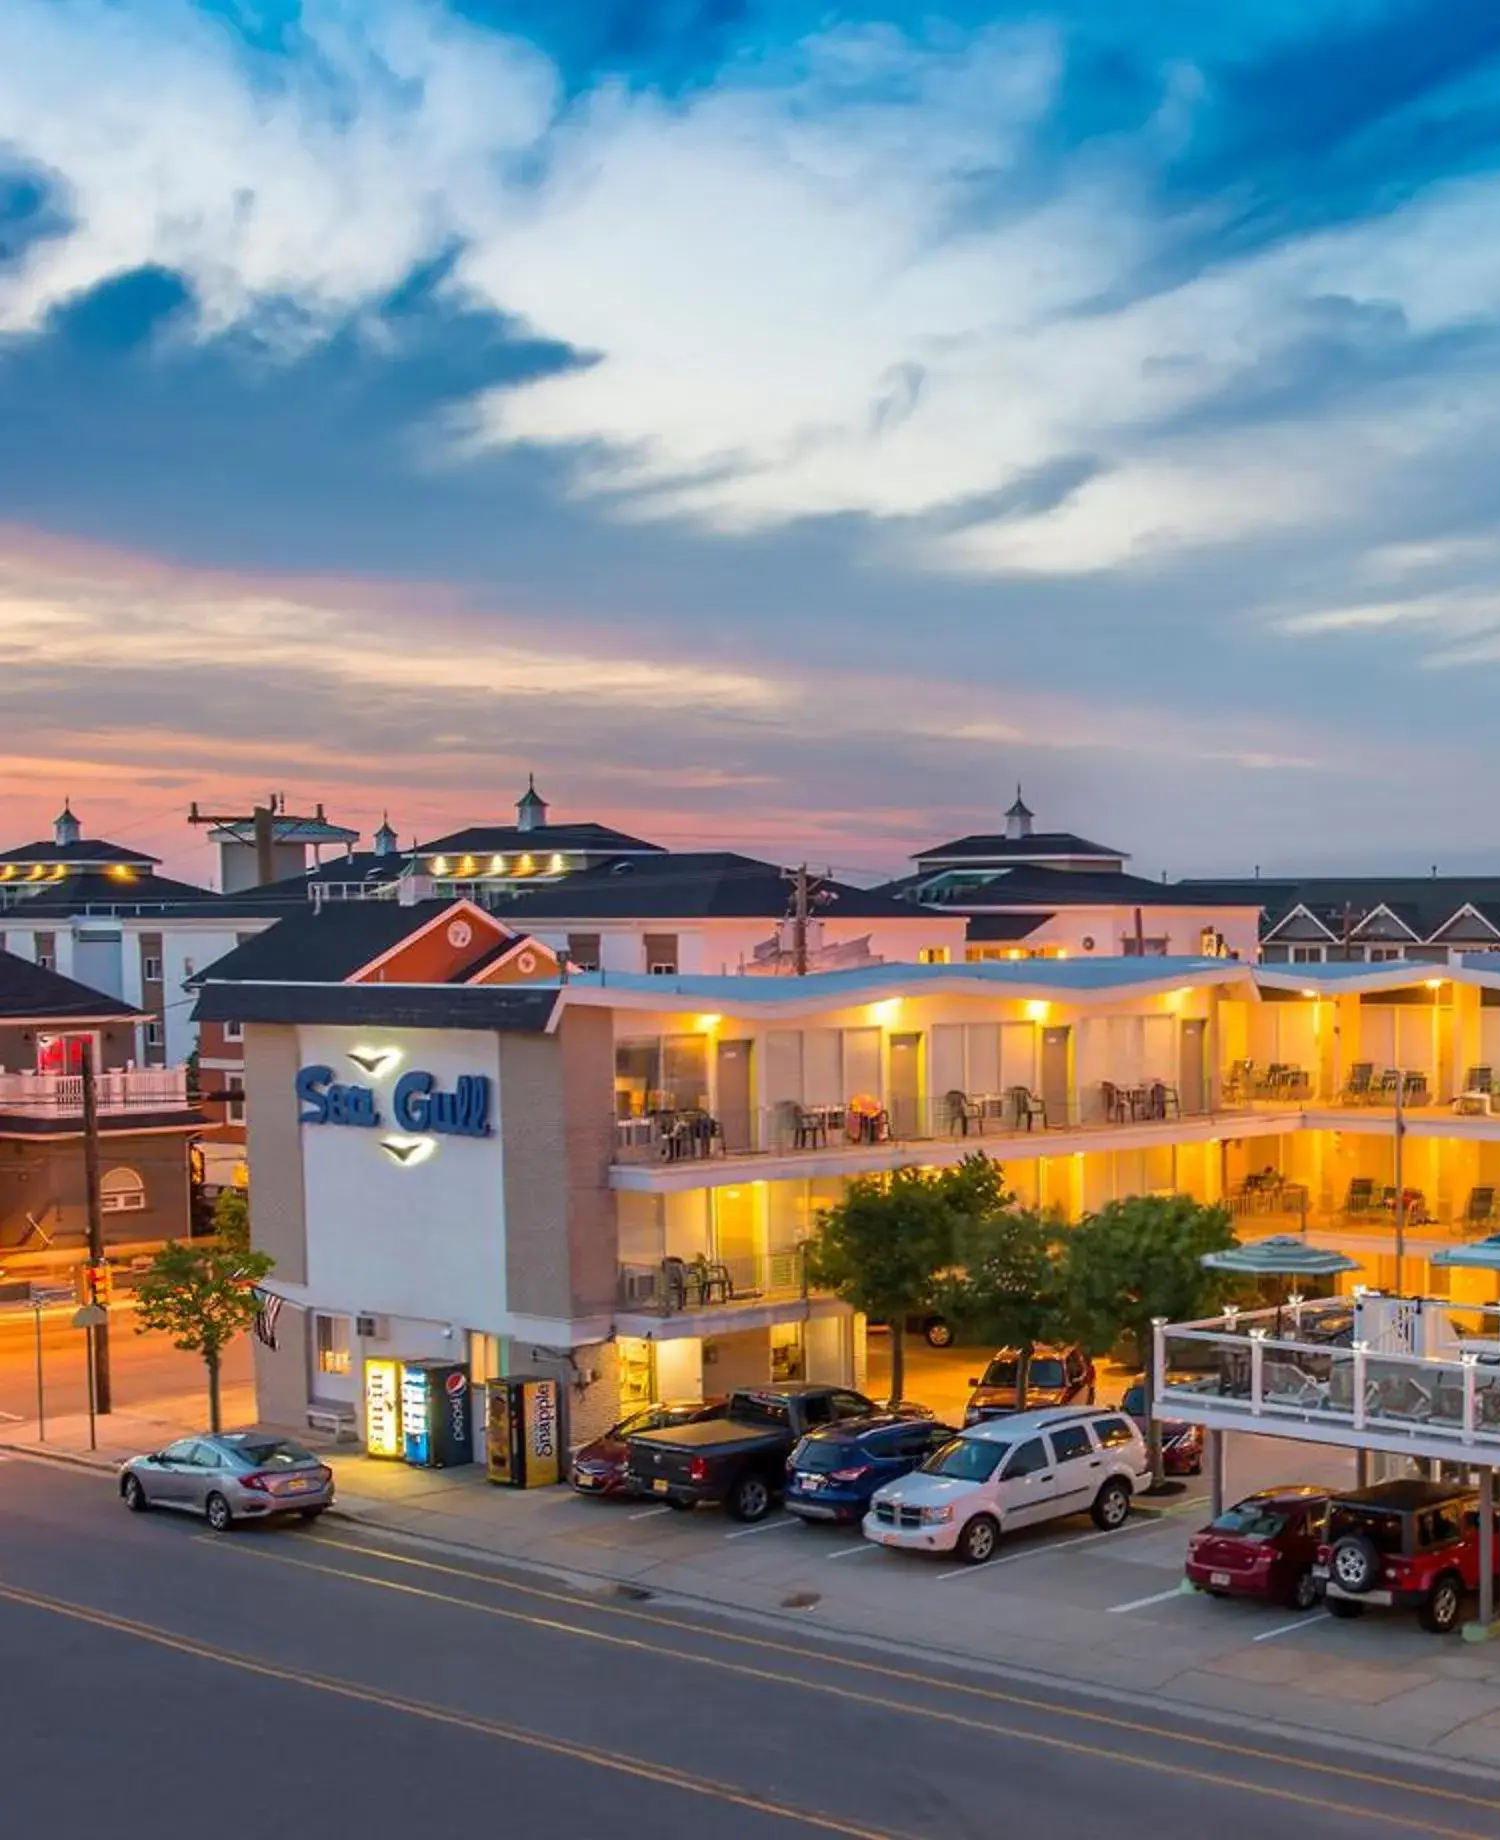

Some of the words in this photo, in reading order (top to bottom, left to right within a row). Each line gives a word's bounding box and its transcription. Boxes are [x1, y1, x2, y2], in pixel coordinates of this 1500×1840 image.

[295, 1065, 381, 1127] Sea
[394, 1071, 494, 1137] Gull
[535, 1383, 554, 1456] Snapple
